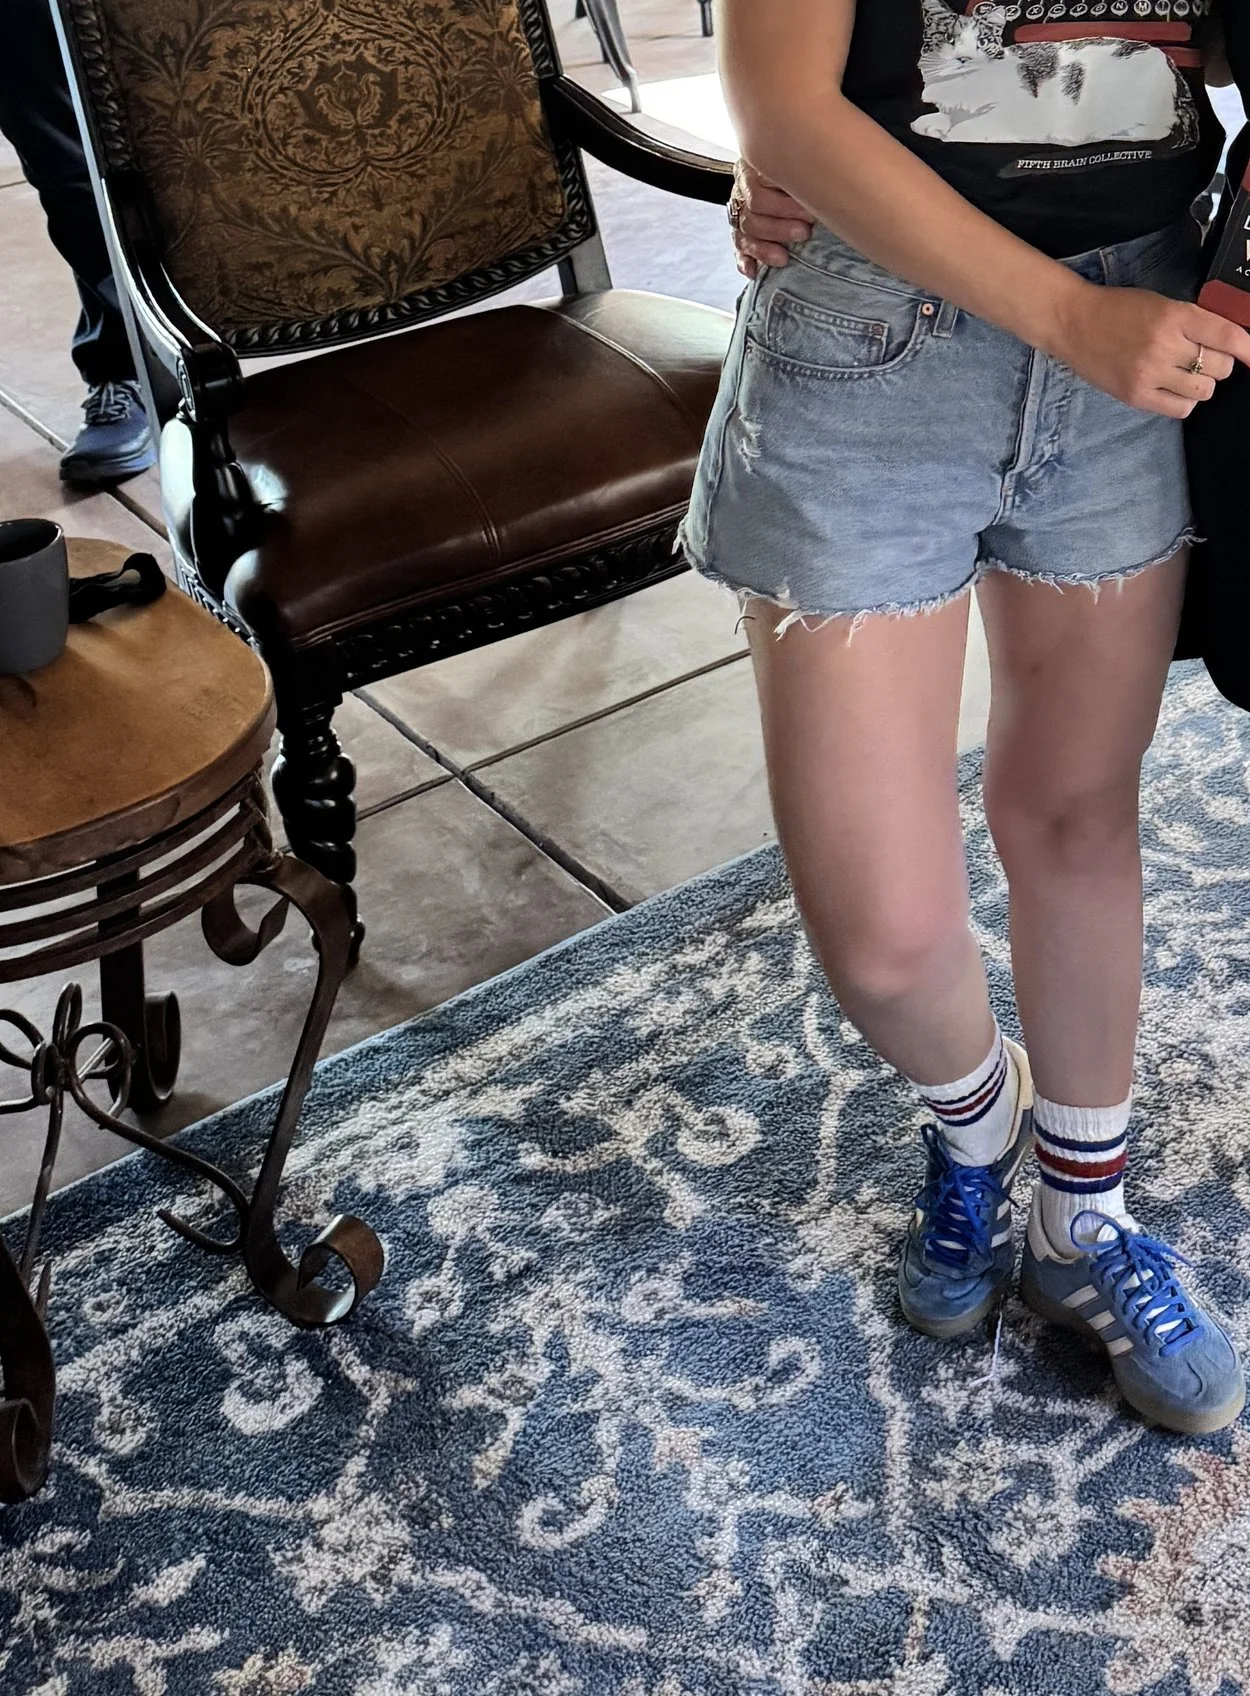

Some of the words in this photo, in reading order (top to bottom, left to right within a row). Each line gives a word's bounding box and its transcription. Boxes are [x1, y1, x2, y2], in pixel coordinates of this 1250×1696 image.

[1016, 159, 1051, 169] FIFTH
[1053, 157, 1087, 169] BRAIN
[1088, 150, 1153, 165] COLLECTIVE
[1235, 266, 1243, 274] A
